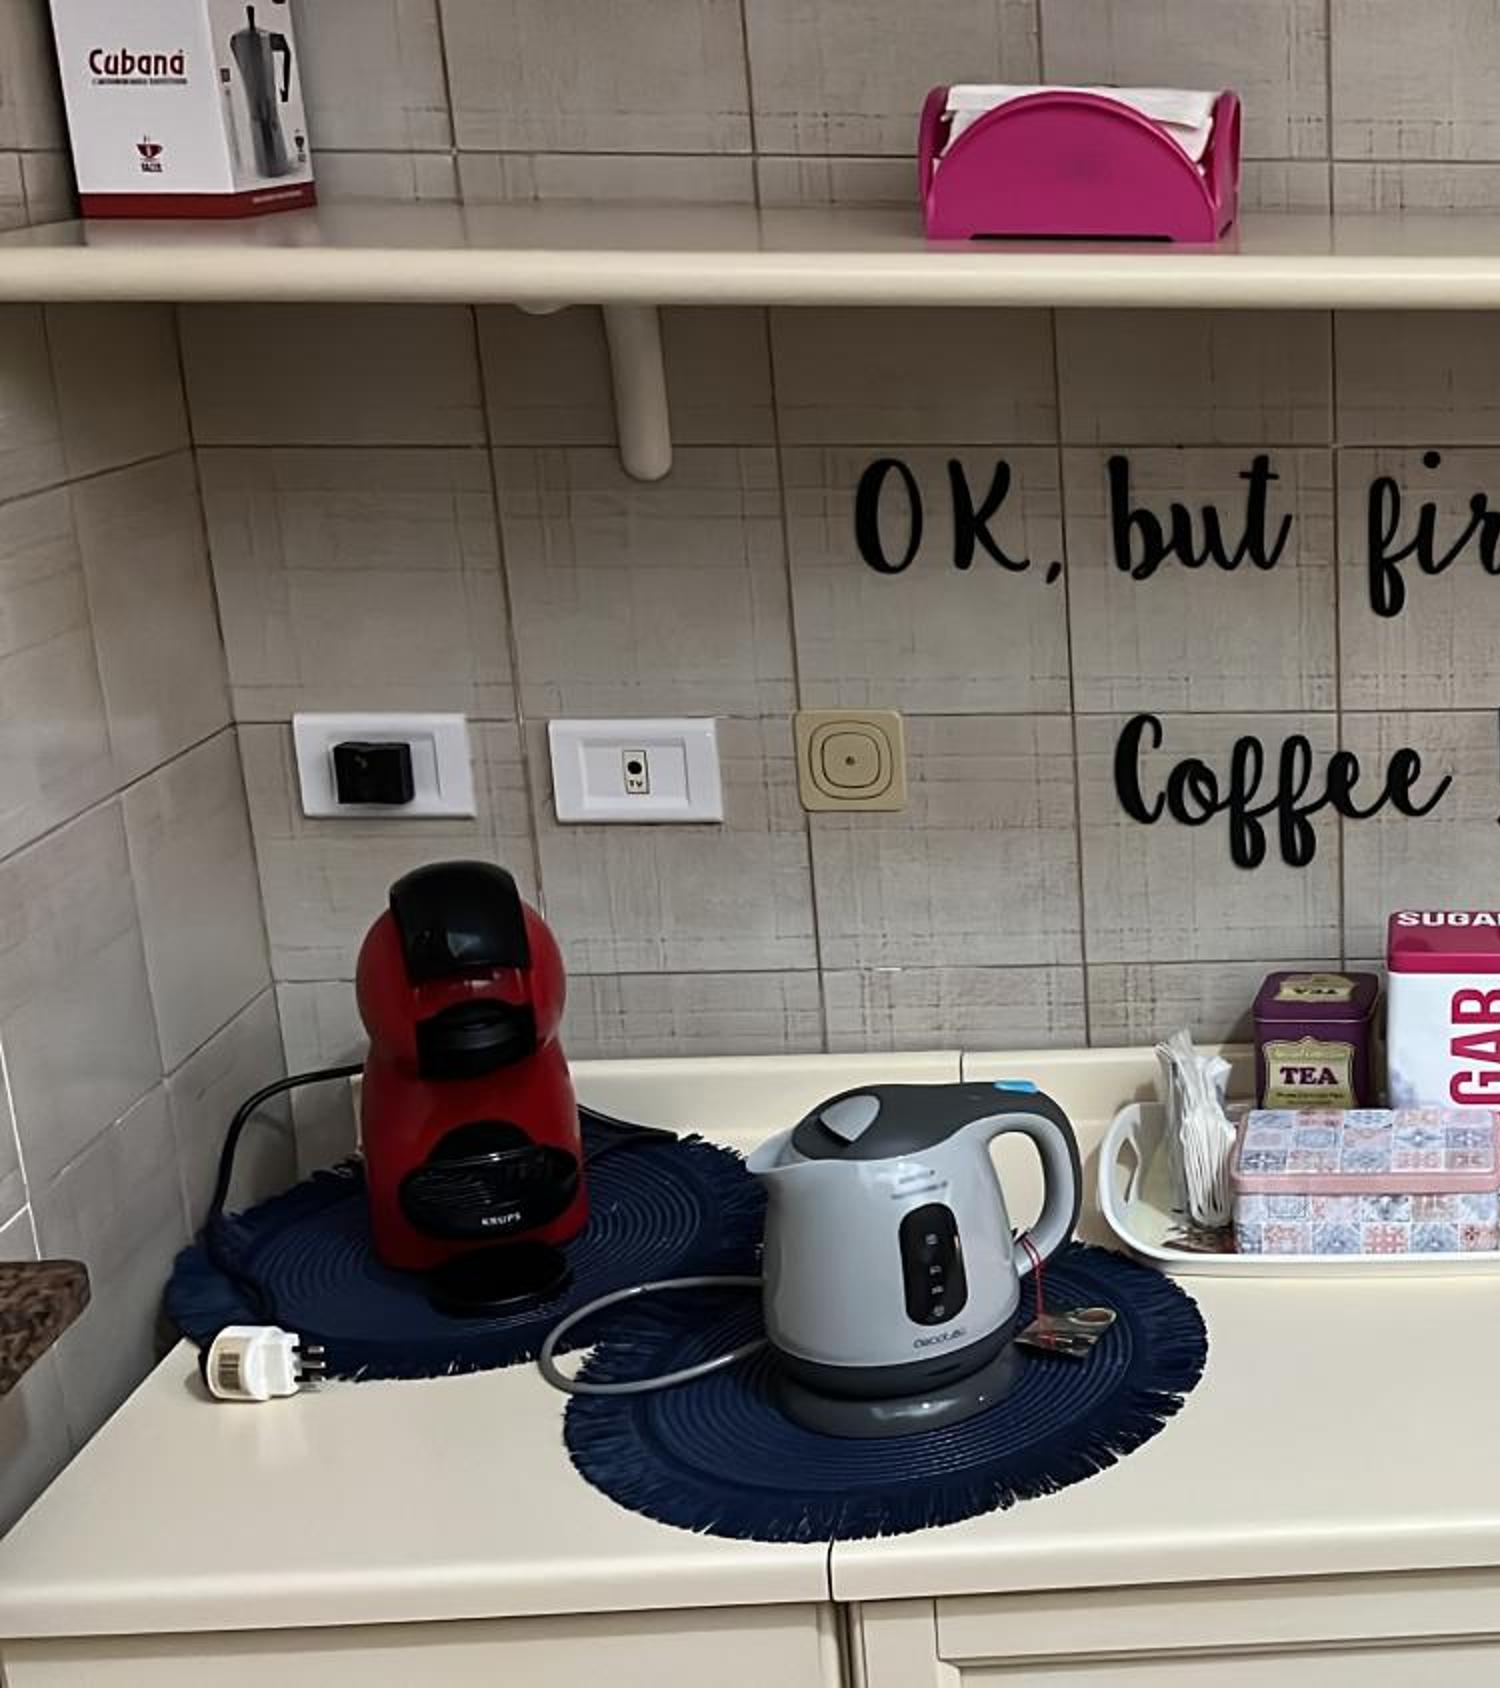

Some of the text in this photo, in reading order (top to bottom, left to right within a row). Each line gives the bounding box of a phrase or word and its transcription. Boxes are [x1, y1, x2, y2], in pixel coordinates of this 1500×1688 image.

[1106, 454, 1294, 581] but
[1113, 712, 1453, 870] Coffee
[1279, 1067, 1339, 1085] TEA
